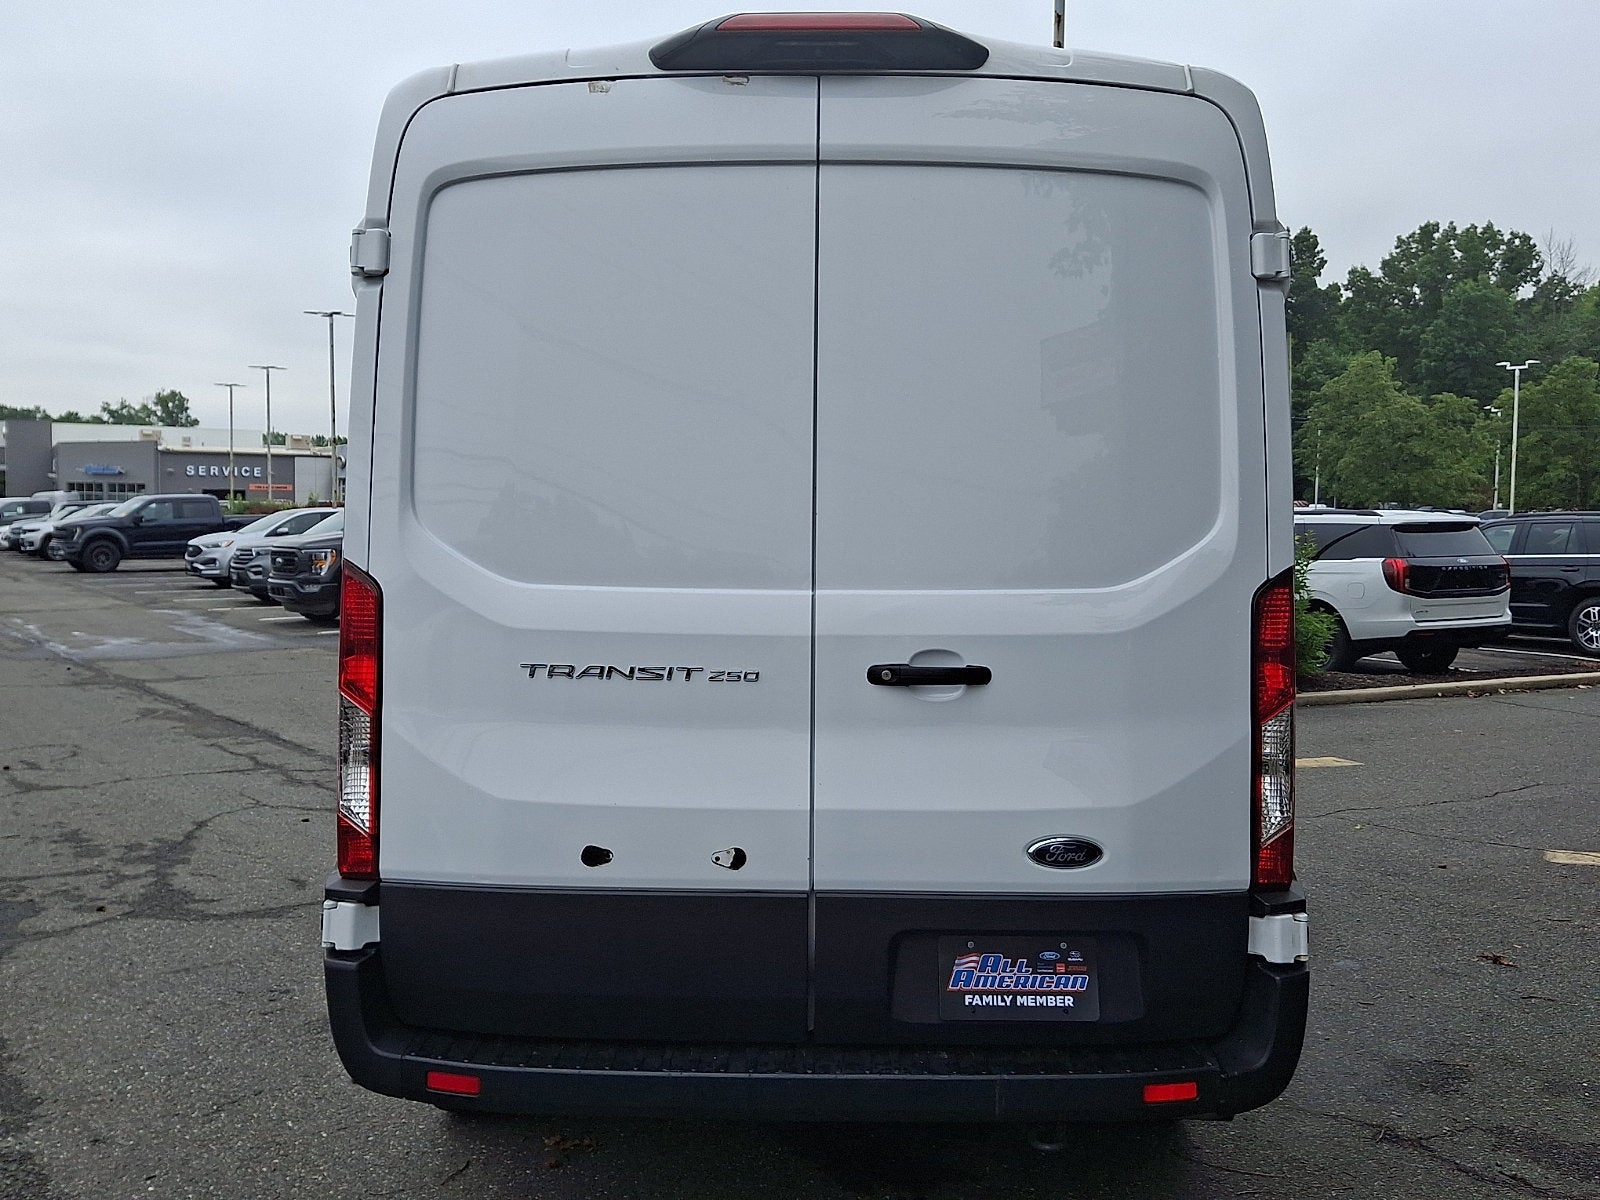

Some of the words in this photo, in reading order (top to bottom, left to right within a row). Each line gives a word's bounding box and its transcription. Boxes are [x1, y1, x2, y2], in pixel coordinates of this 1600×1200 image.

[186, 465, 262, 477] SERVICE
[520, 663, 704, 681] TRANSIT
[708, 670, 760, 682] 250
[1045, 844, 1086, 861] Ford
[964, 994, 1012, 1006] FAMILY
[1016, 995, 1074, 1007] MEMBER
